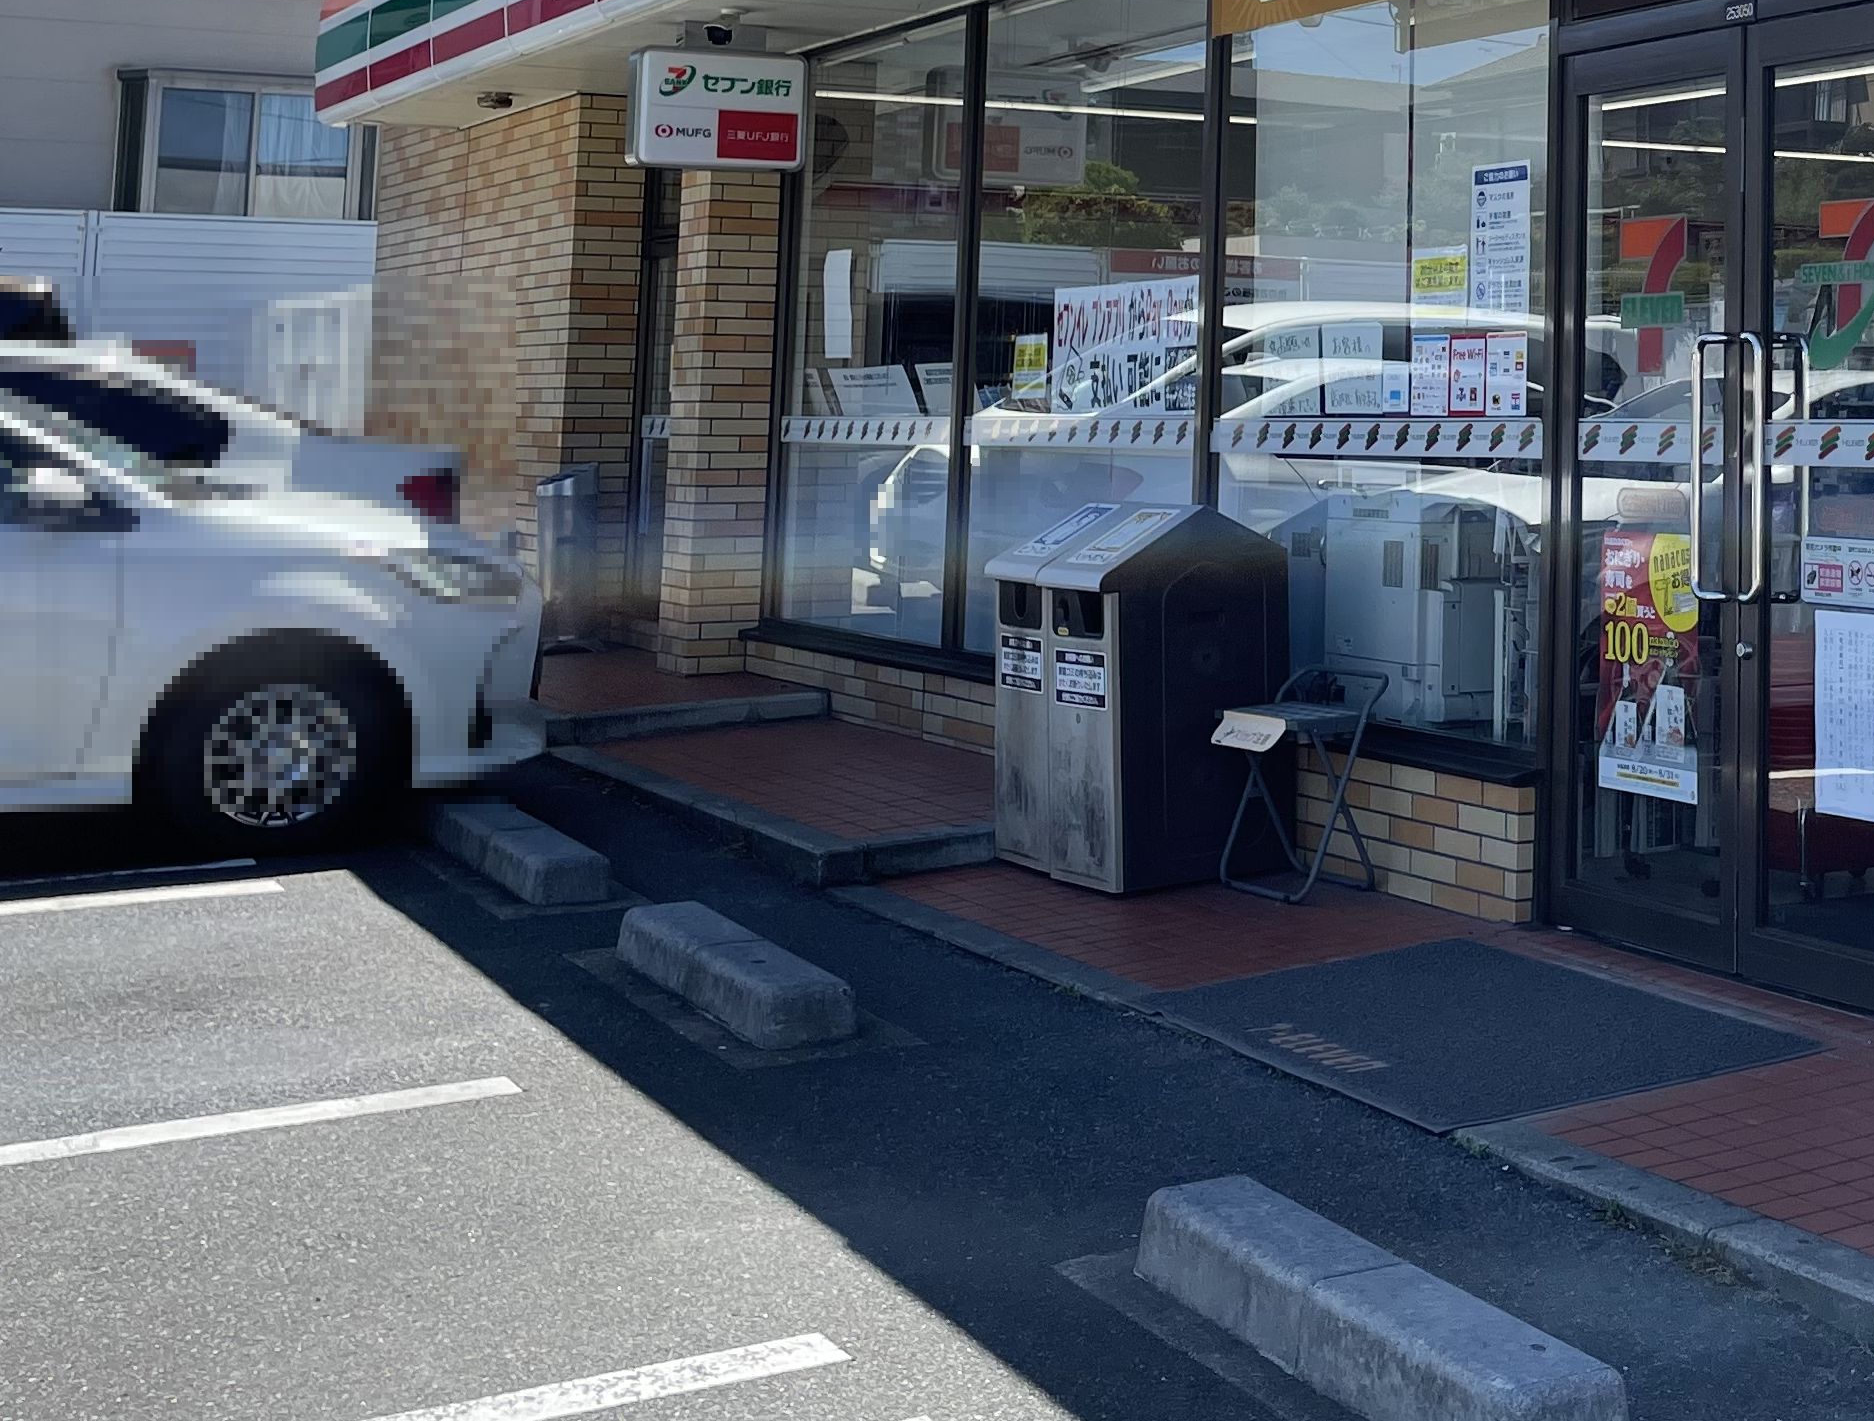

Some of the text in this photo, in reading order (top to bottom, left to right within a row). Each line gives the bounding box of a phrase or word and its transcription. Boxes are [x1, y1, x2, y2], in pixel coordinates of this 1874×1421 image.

[702, 74, 792, 97] セブン銀行
[676, 127, 712, 138] MUFG
[727, 130, 790, 143] 三菱UFJ銀行
[1605, 621, 1649, 665] 100
